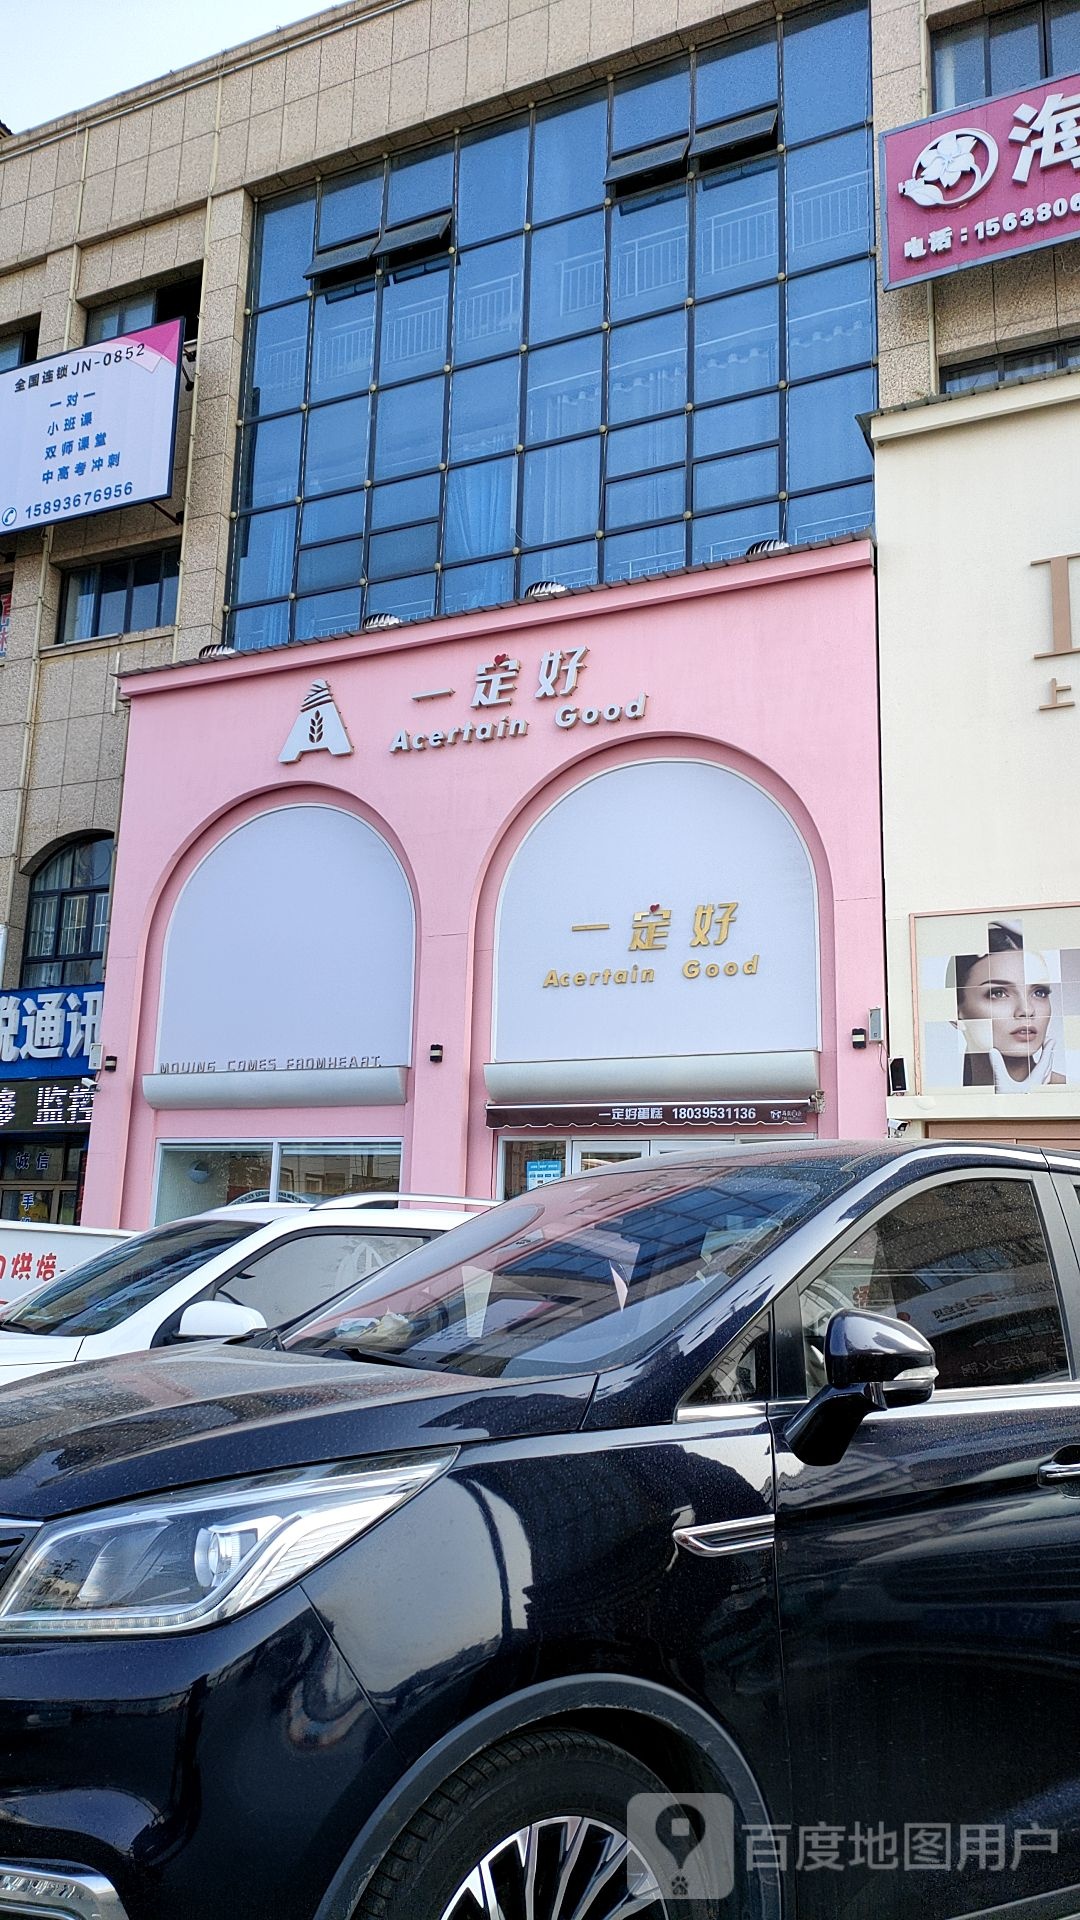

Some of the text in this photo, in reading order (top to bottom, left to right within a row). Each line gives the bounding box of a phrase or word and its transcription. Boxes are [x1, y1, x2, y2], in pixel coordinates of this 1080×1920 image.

[1008, 92, 1080, 184] 海
[49, 392, 96, 408] 一对一
[47, 411, 93, 437] 小班课
[44, 432, 107, 461] 双师课堂
[41, 451, 121, 485] 中高考冲刺
[25, 481, 134, 520] 15893676956
[410, 645, 591, 709] 一定好
[389, 692, 650, 754] Acertain Good
[571, 902, 739, 952] 一定好
[543, 954, 760, 988] Acertain Good
[598, 1106, 757, 1120] 一定好蛋糕 18039531136
[16, 1151, 50, 1171] 诚信
